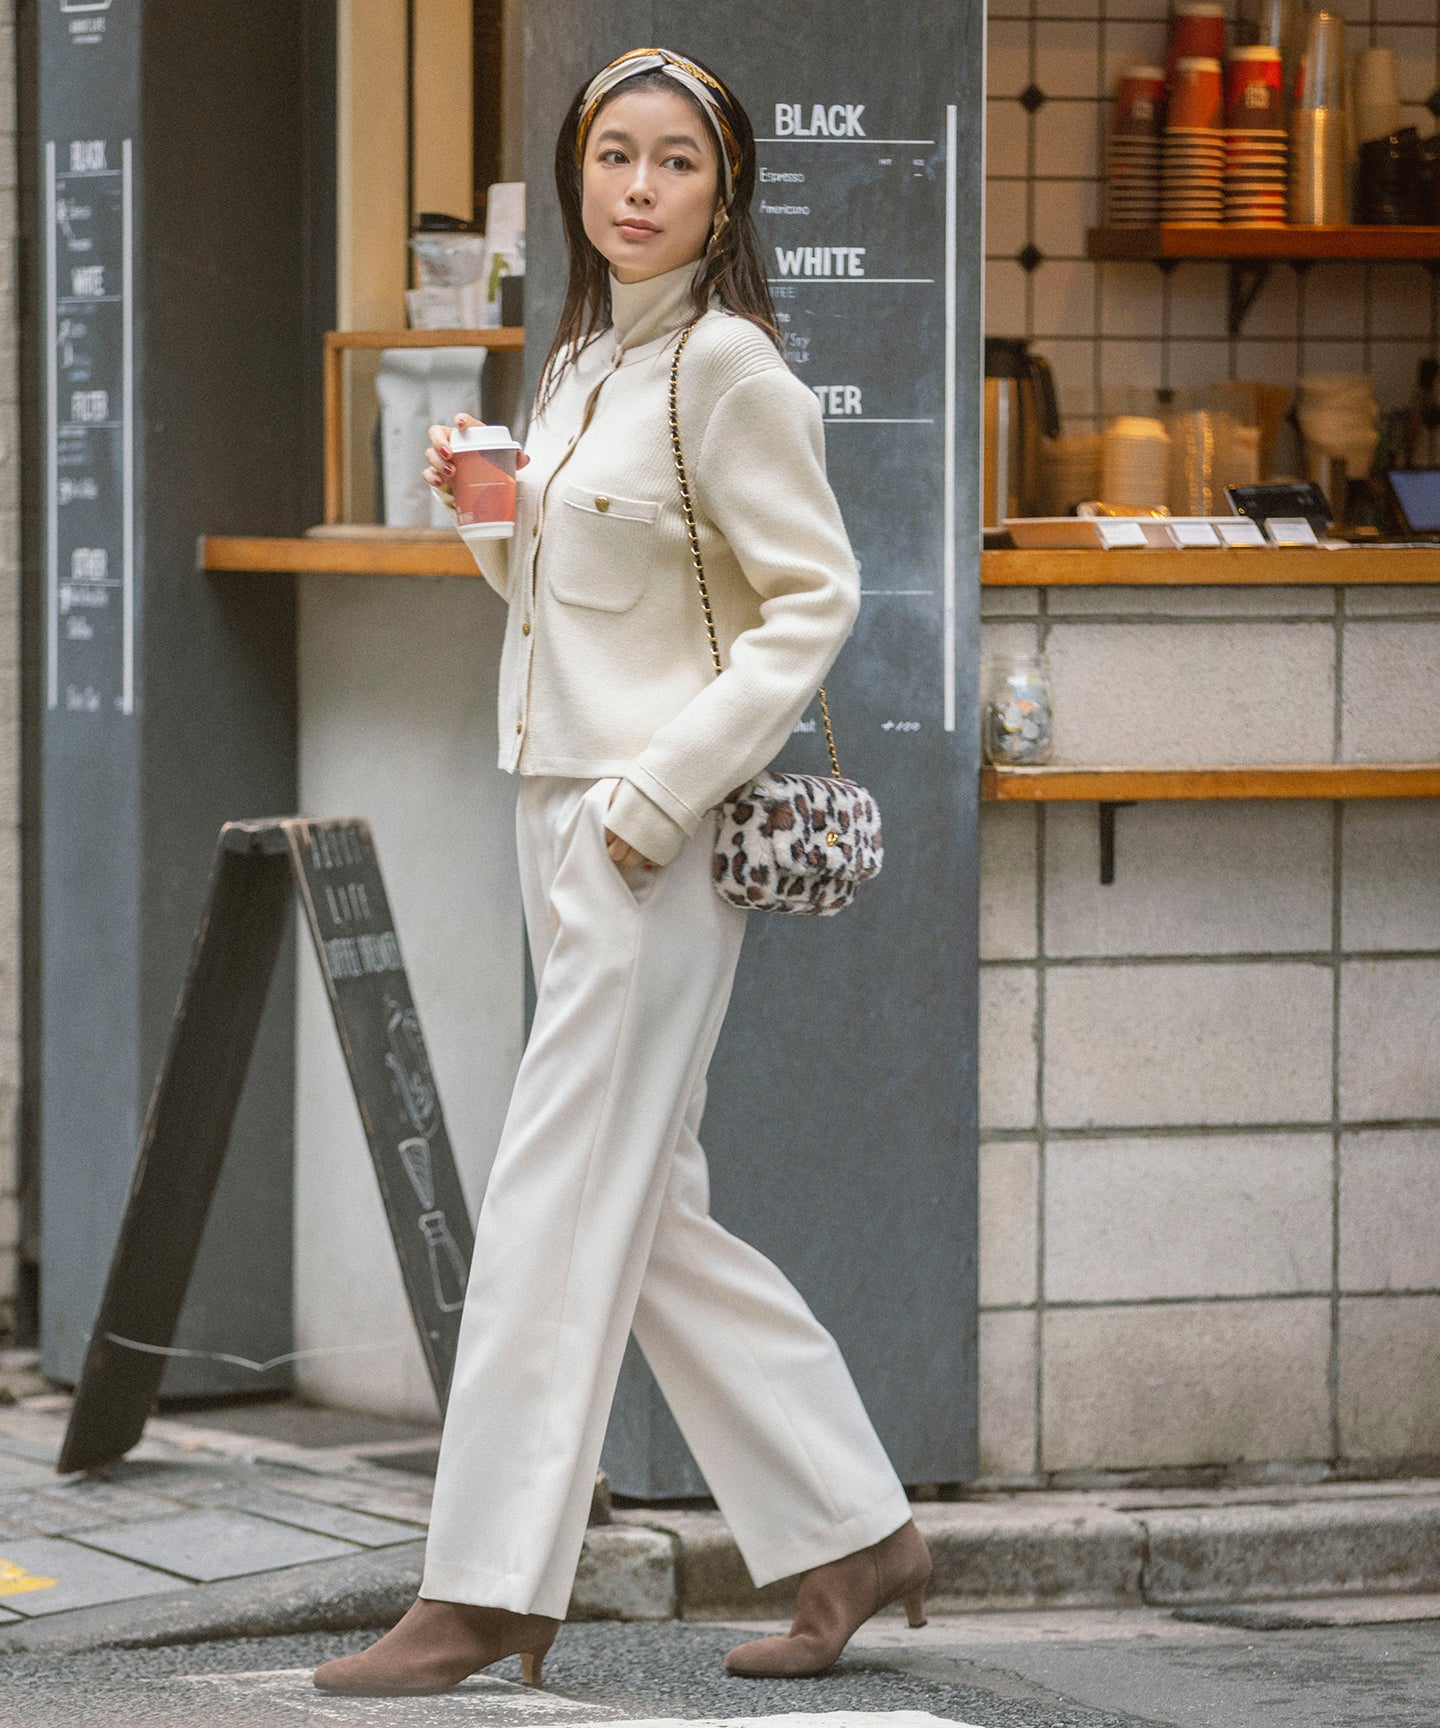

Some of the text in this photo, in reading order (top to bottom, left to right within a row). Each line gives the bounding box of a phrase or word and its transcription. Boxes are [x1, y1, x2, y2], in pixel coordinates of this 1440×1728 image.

[775, 103, 866, 136] BLACK
[759, 167, 805, 183] Espresso
[759, 200, 810, 215] Americano
[775, 246, 866, 276] WHITE
[812, 385, 863, 415] TER
